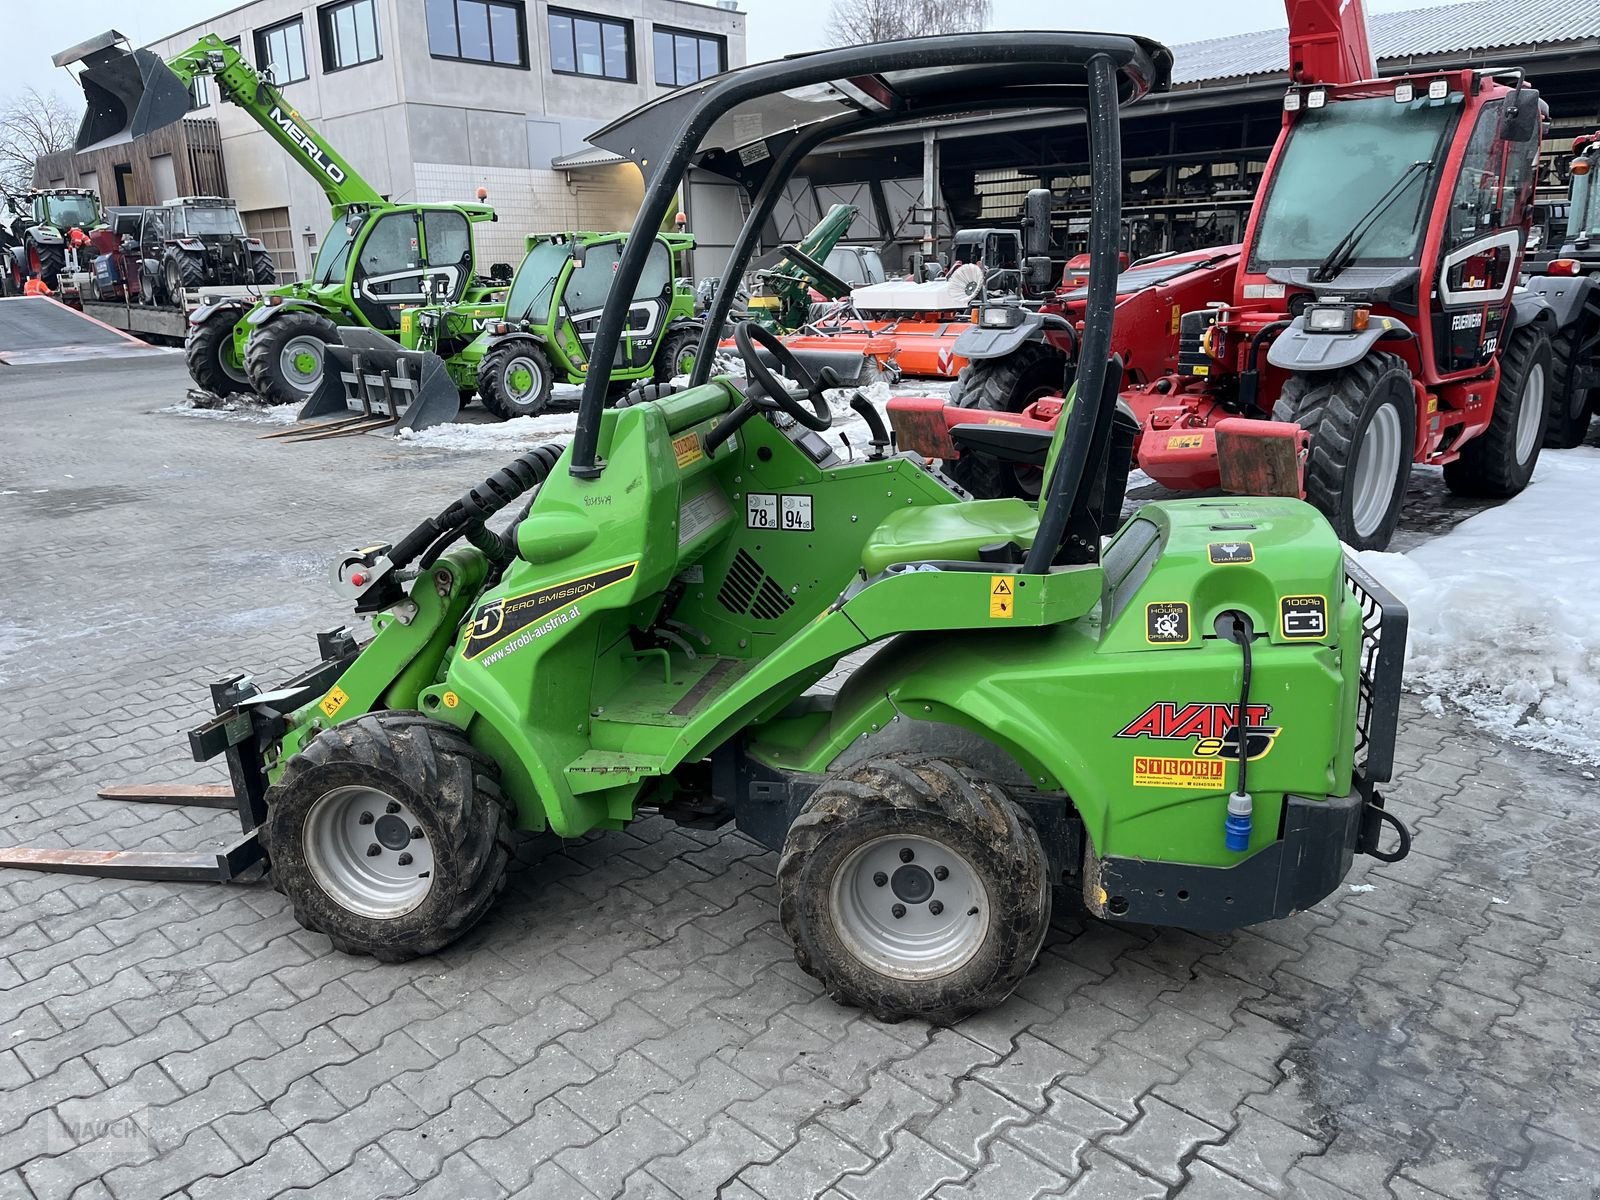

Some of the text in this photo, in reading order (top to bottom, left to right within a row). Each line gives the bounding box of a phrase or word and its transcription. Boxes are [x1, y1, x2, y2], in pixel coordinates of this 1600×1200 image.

[269, 106, 345, 183] MERLO
[1452, 313, 1482, 331] FEUERWEHR
[750, 508, 768, 526] 78
[785, 510, 802, 528] 94
[505, 582, 597, 615] ZERO EMISSION
[481, 604, 582, 668] www.strobl-austria.at
[1136, 758, 1223, 776] STROBL
